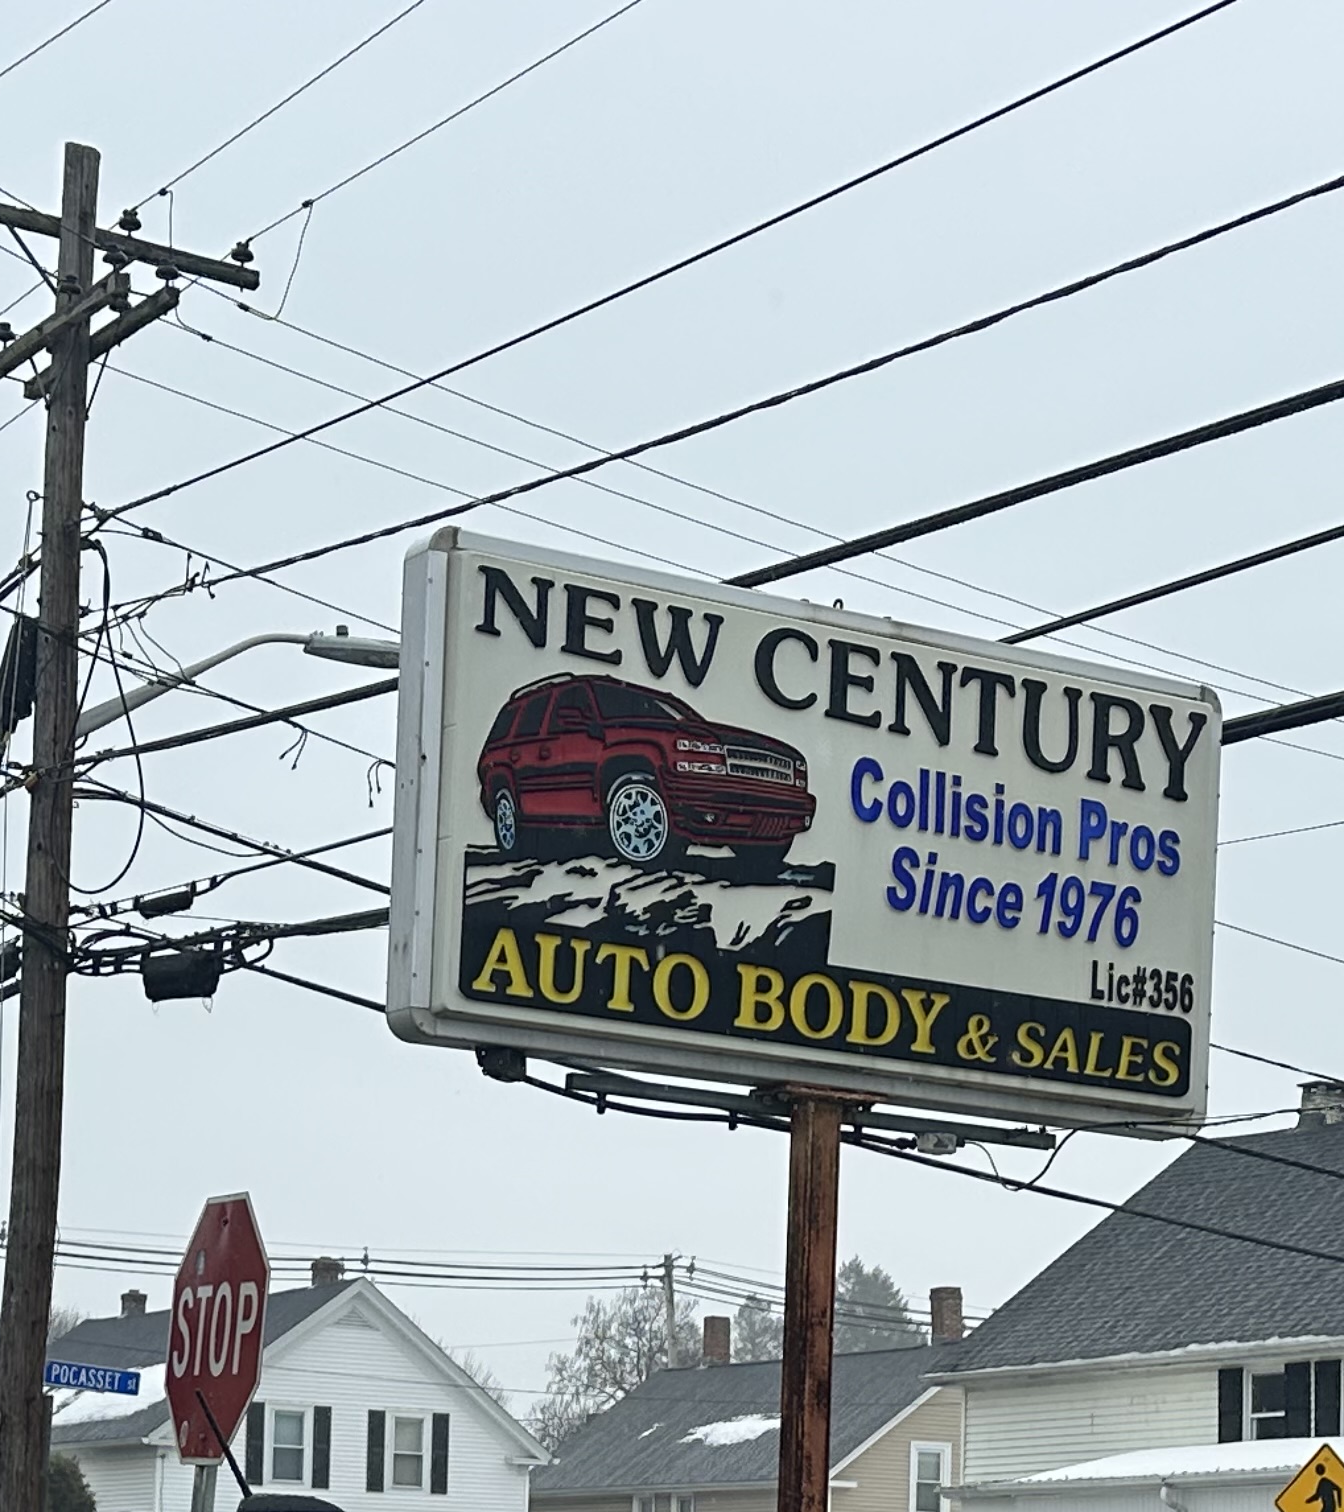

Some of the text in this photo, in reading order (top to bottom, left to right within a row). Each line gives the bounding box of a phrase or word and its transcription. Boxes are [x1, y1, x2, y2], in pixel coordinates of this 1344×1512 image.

[475, 564, 1208, 801] NEW CENTURY
[850, 757, 1181, 876] Collision Pros
[886, 846, 1142, 948] Since 1976
[471, 928, 1181, 1086] AUTO BODY & SALES
[1090, 960, 1194, 1013] Lic#356
[51, 1363, 121, 1390] POCASSET
[172, 1281, 259, 1378] STOP
